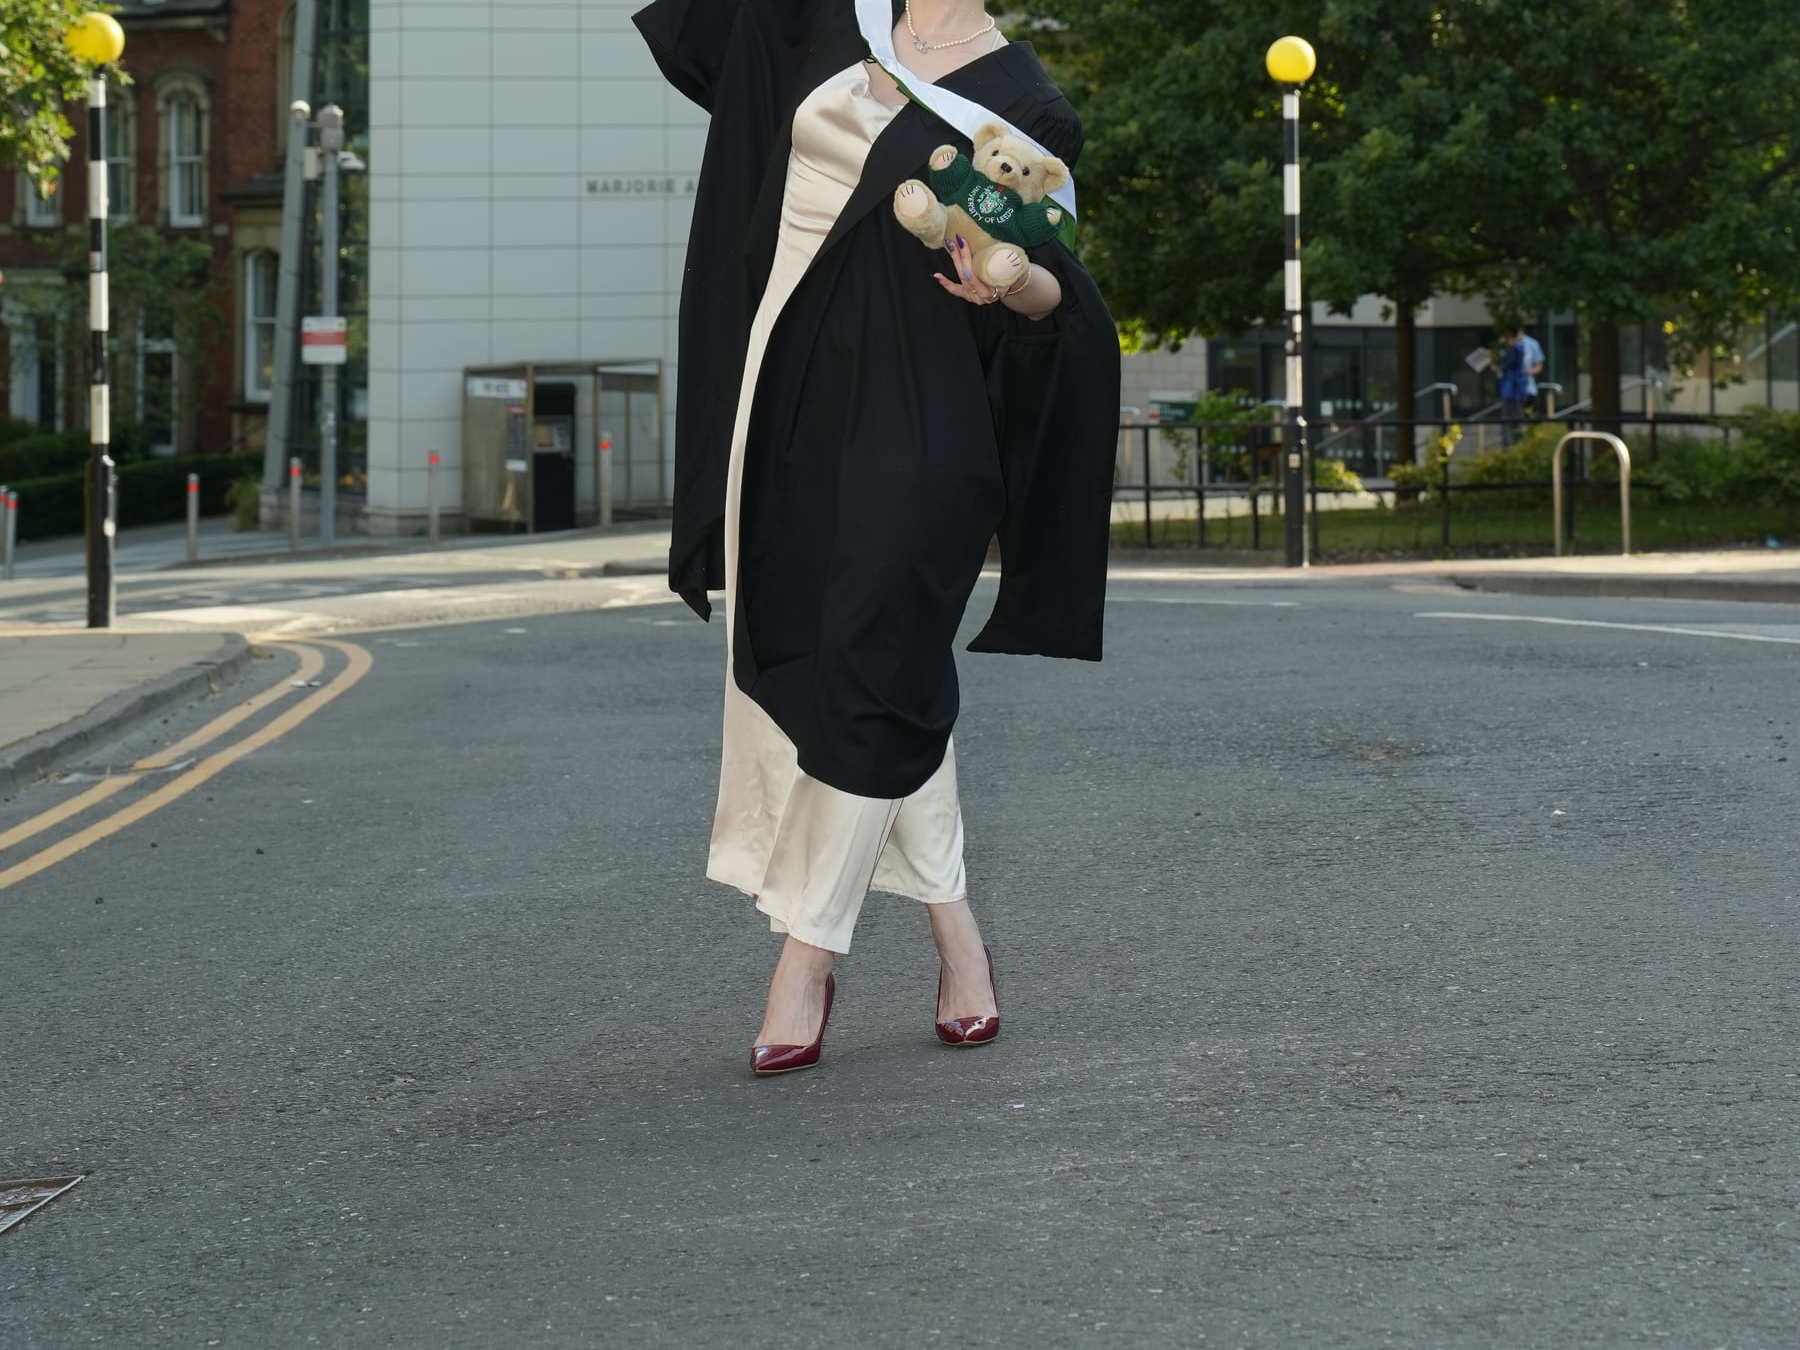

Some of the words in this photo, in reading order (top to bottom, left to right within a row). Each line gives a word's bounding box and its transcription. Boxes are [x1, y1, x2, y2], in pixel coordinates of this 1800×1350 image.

[587, 179, 675, 194] MARJORIE
[968, 186, 983, 221] UNIVERSITY
[996, 208, 1014, 223] LEEDS
